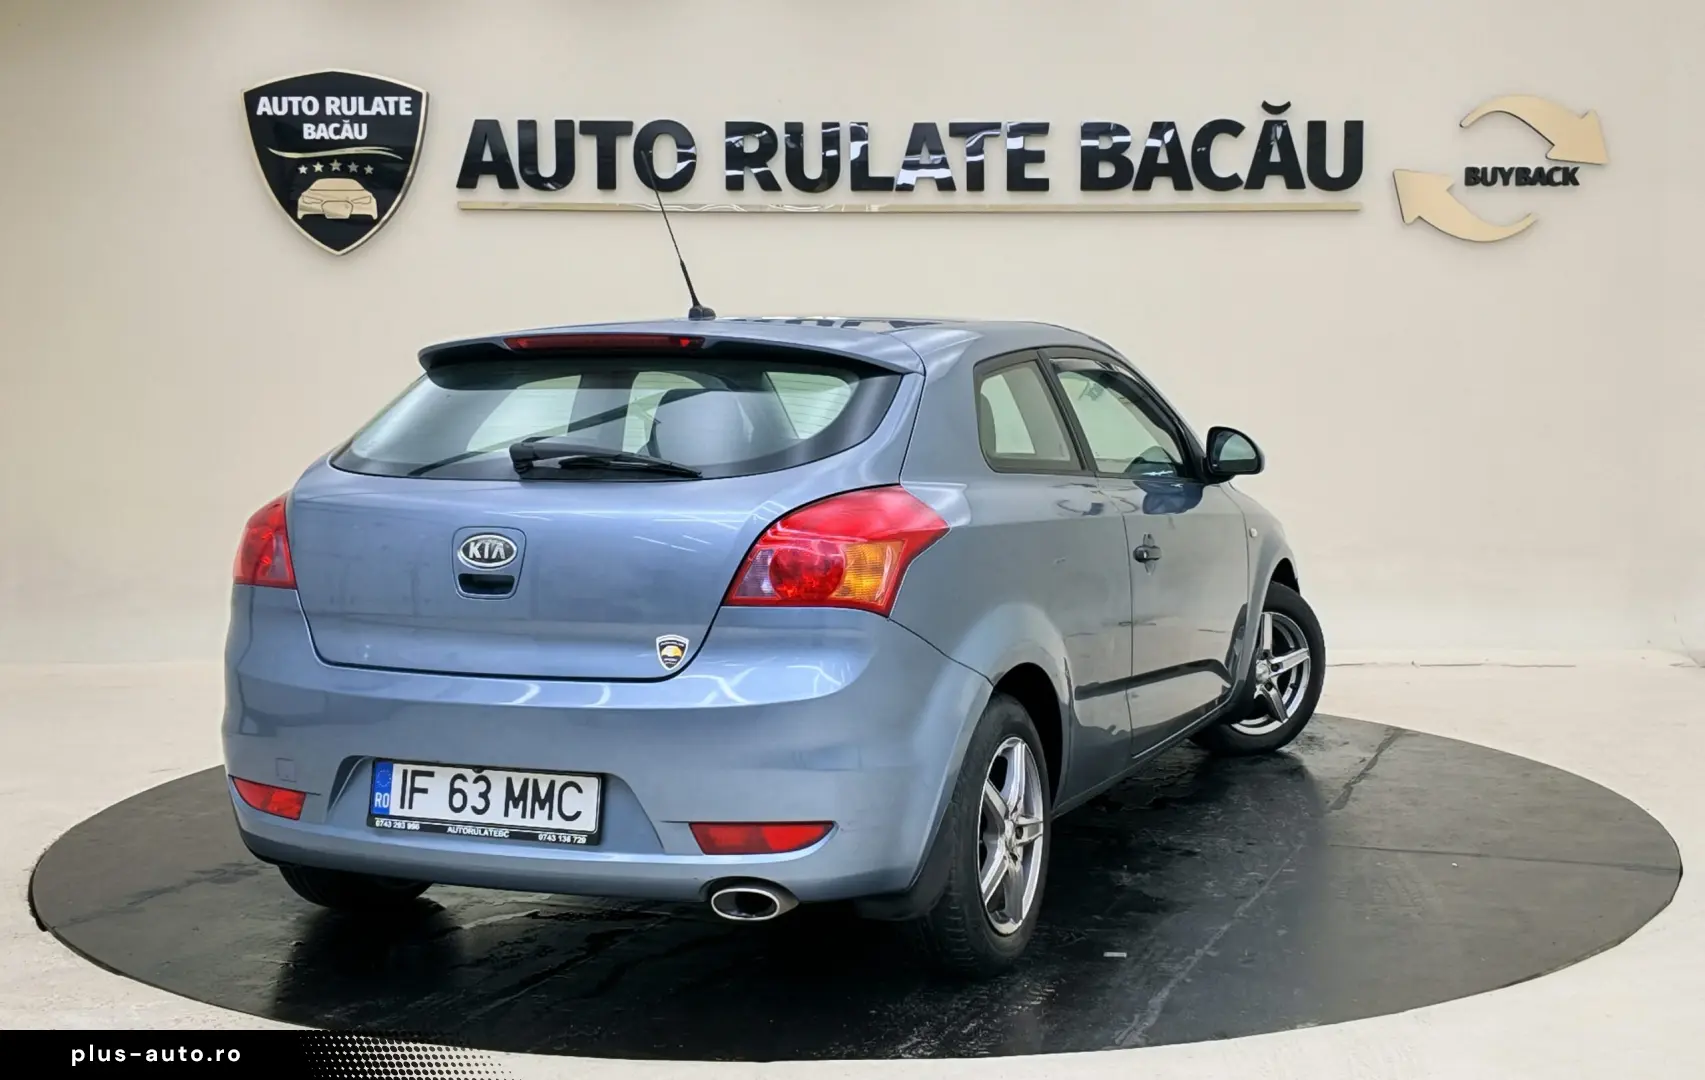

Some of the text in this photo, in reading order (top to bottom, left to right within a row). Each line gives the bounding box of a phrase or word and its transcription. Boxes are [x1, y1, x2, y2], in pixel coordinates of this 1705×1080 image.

[256, 96, 412, 116] AUTO RULATE
[303, 119, 367, 140] BACĂU
[456, 100, 1364, 194] AUTO RULATE BACĂU
[1464, 166, 1580, 187] BUYBACK
[469, 540, 506, 560] KIA
[374, 792, 390, 809] RO
[400, 769, 584, 822] IF 63 MMC
